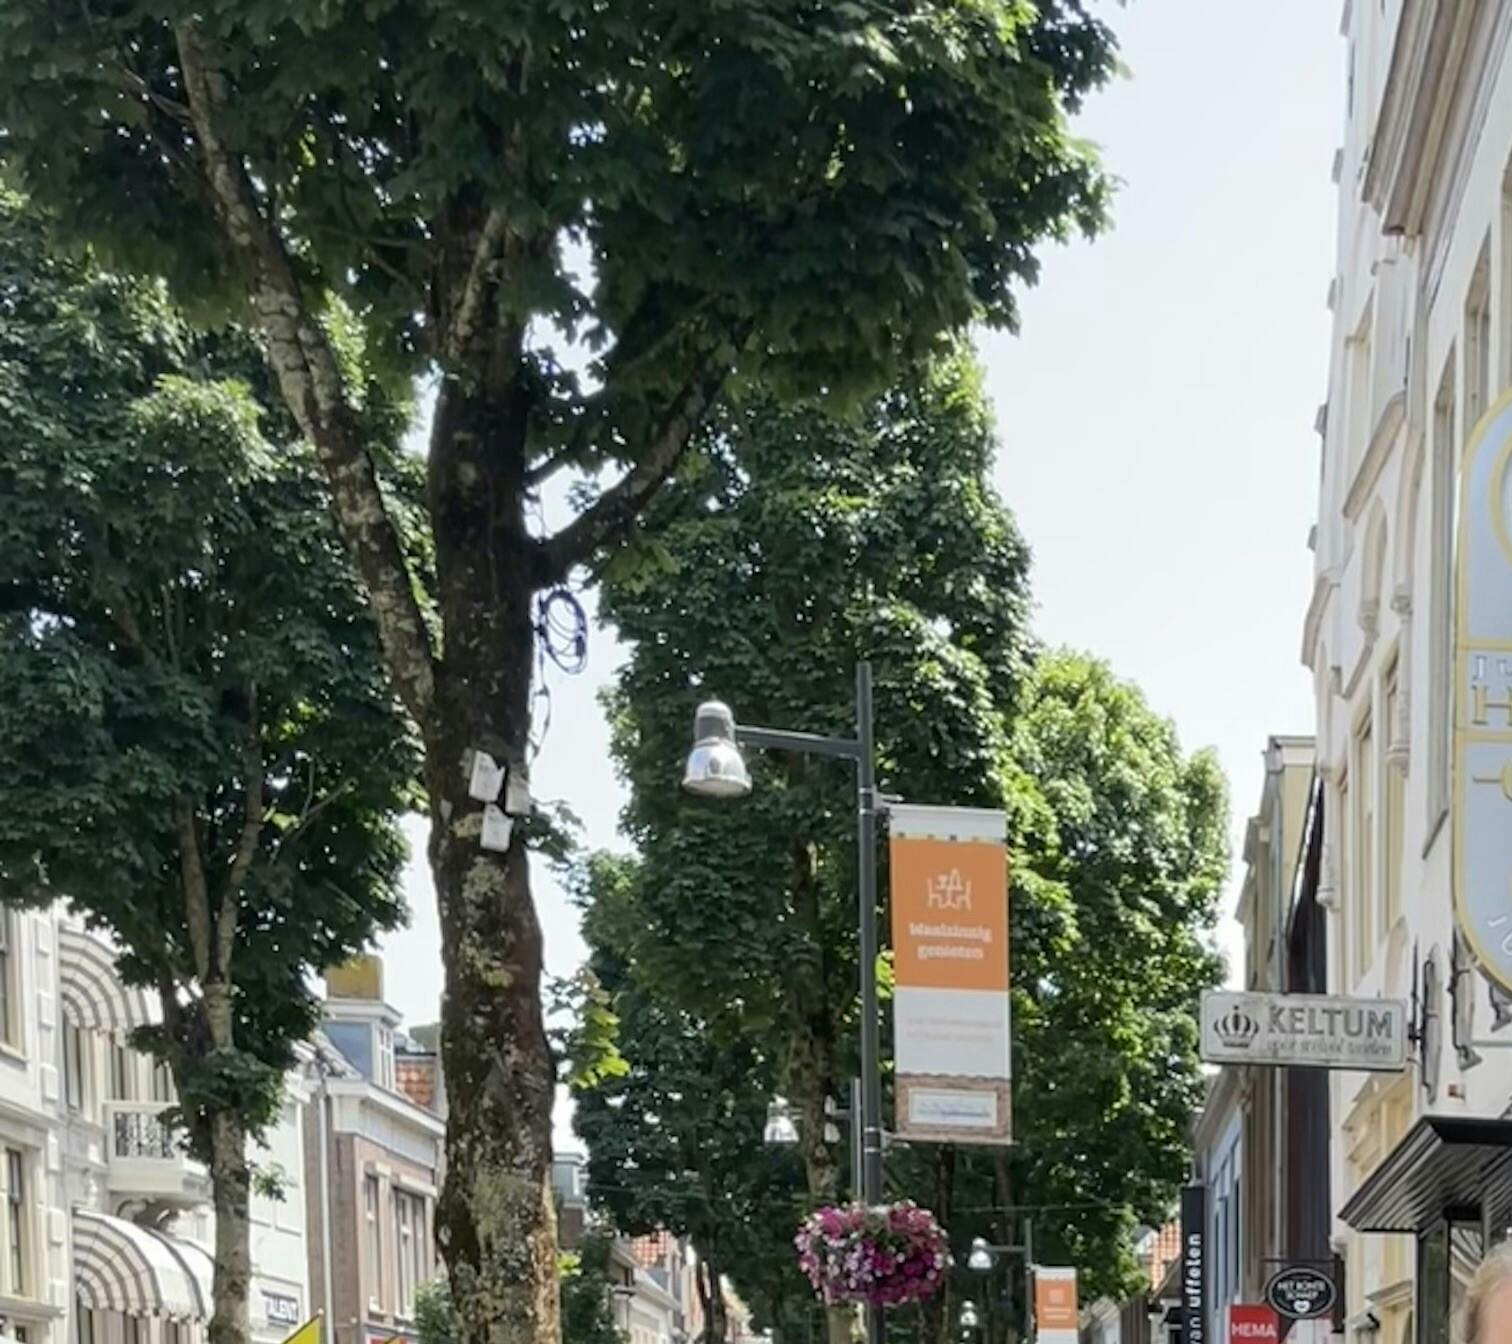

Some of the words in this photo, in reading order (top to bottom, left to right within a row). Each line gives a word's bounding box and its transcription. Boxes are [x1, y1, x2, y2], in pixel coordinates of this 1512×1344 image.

[1266, 1003, 1393, 1039] KELTUM
[1185, 1233, 1202, 1307] uffelen
[1231, 1321, 1277, 1338] HEMA
